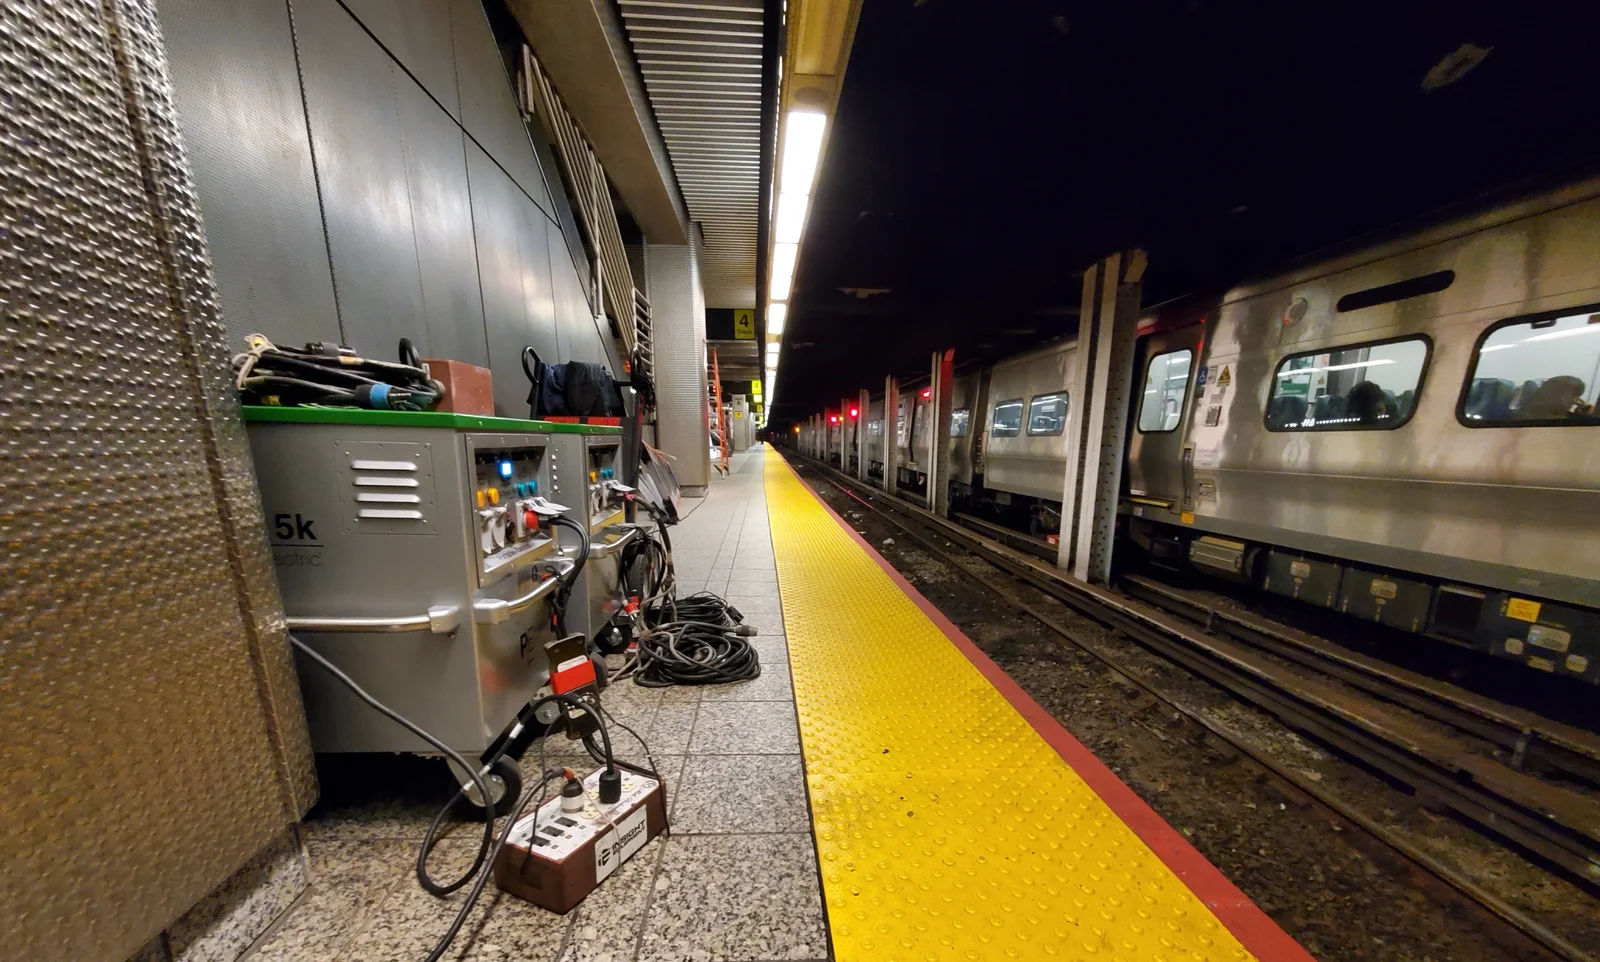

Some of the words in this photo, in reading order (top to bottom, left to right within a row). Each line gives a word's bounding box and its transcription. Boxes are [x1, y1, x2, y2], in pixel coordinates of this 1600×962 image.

[739, 314, 750, 328] 4
[275, 513, 318, 540] 5k
[612, 819, 646, 851] INSIGHT
